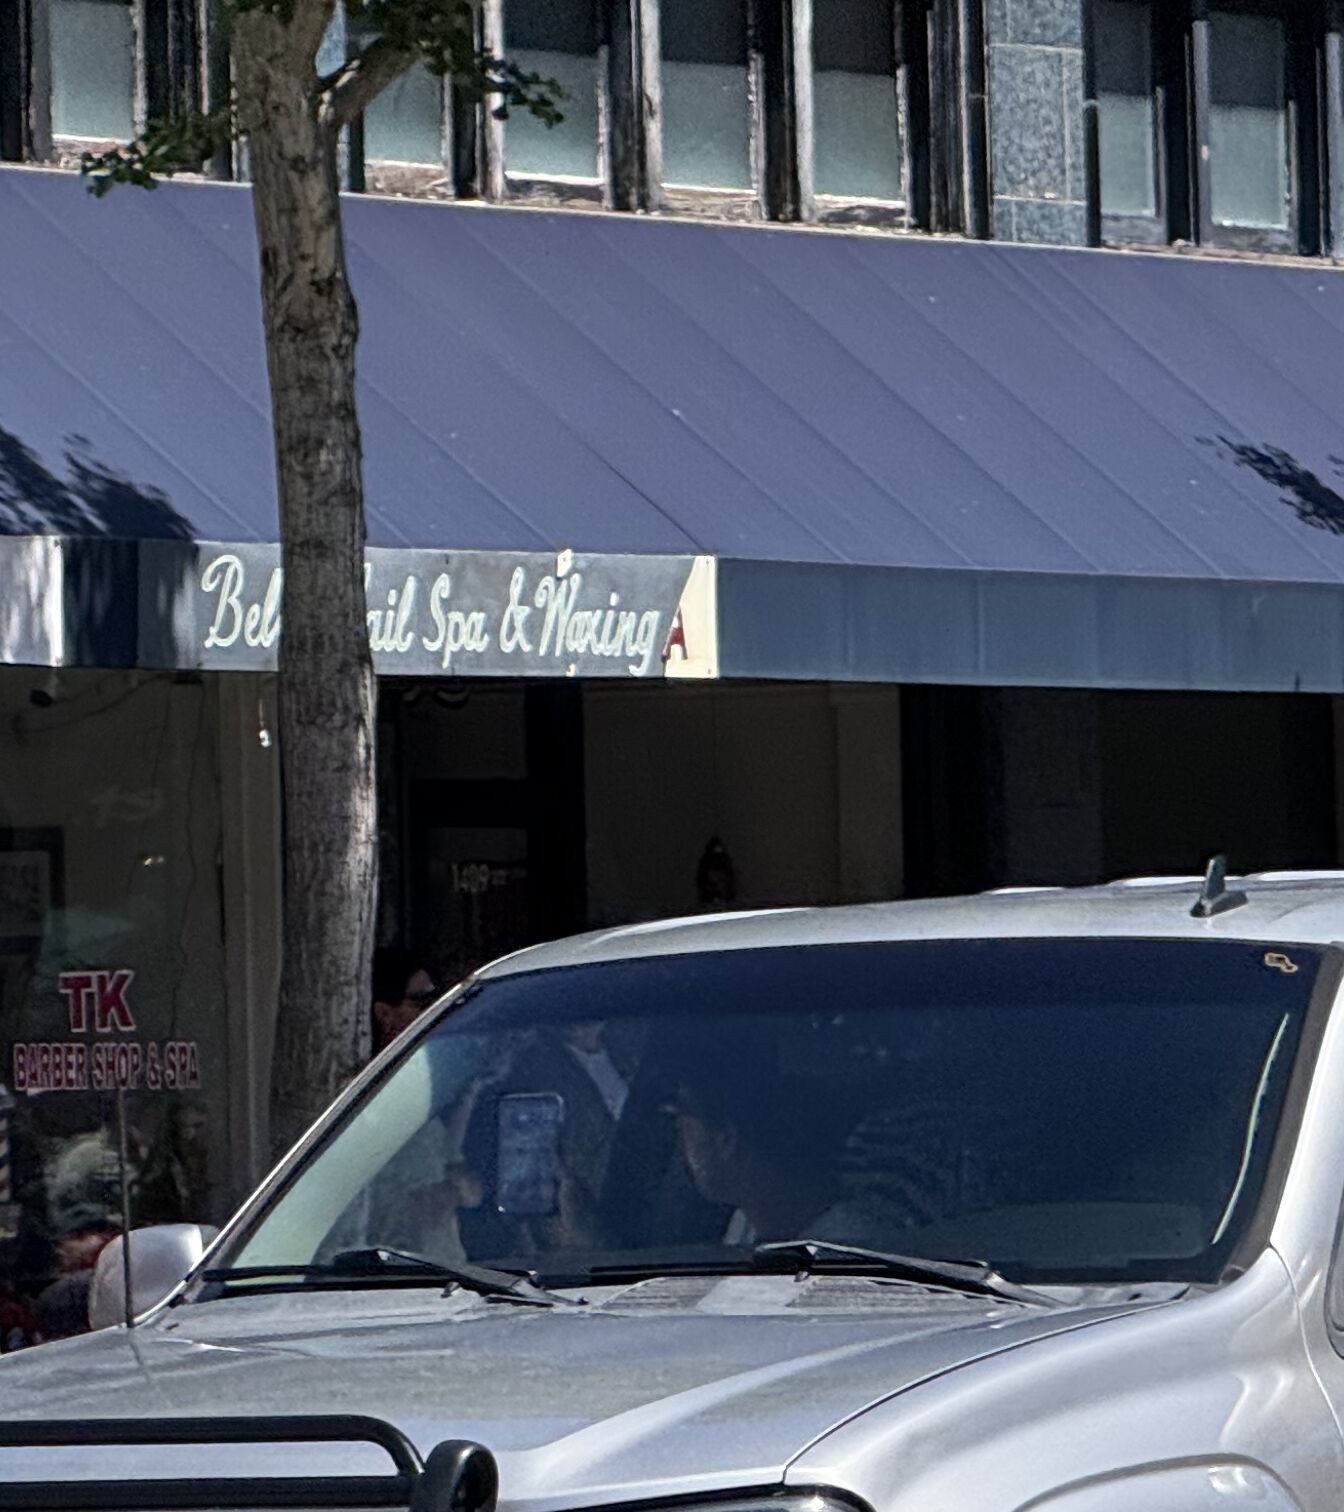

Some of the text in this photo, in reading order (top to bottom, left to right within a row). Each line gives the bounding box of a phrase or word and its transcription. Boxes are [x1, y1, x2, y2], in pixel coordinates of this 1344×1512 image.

[364, 562, 415, 652] ail
[422, 573, 490, 669] Spa
[499, 566, 533, 654] &
[534, 572, 661, 677] Waxing
[58, 969, 137, 1033] TK
[13, 1041, 202, 1091] BARBER SHOP & SPA
